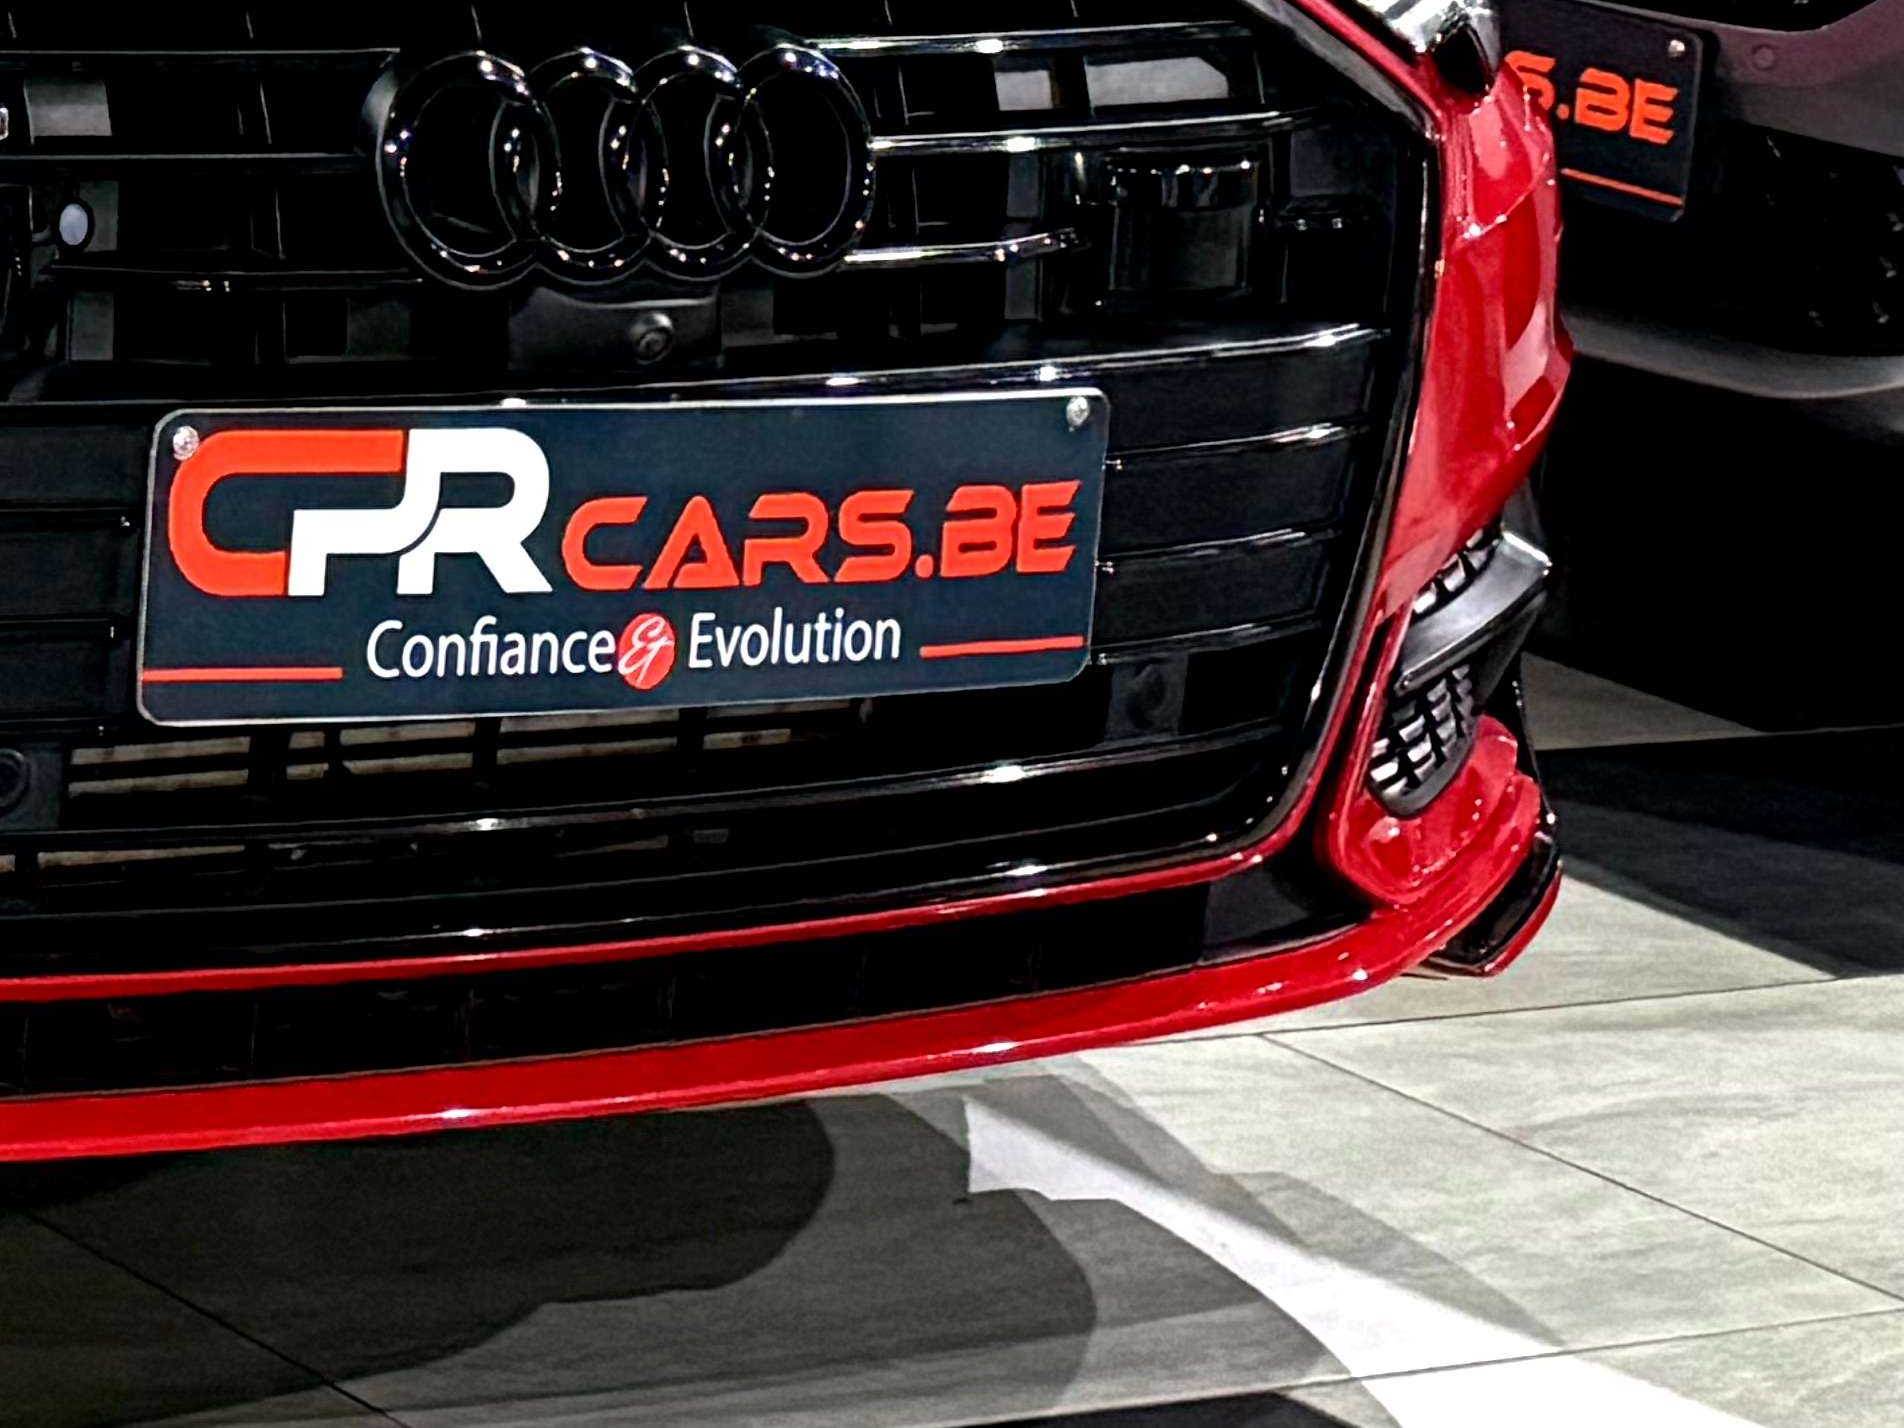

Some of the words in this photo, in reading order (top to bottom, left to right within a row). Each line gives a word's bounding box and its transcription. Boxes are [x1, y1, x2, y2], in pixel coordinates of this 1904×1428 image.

[167, 427, 553, 598] CPR
[561, 479, 1081, 591] CARS.BE
[365, 616, 617, 680] Confiance
[688, 606, 901, 669] Evolution
